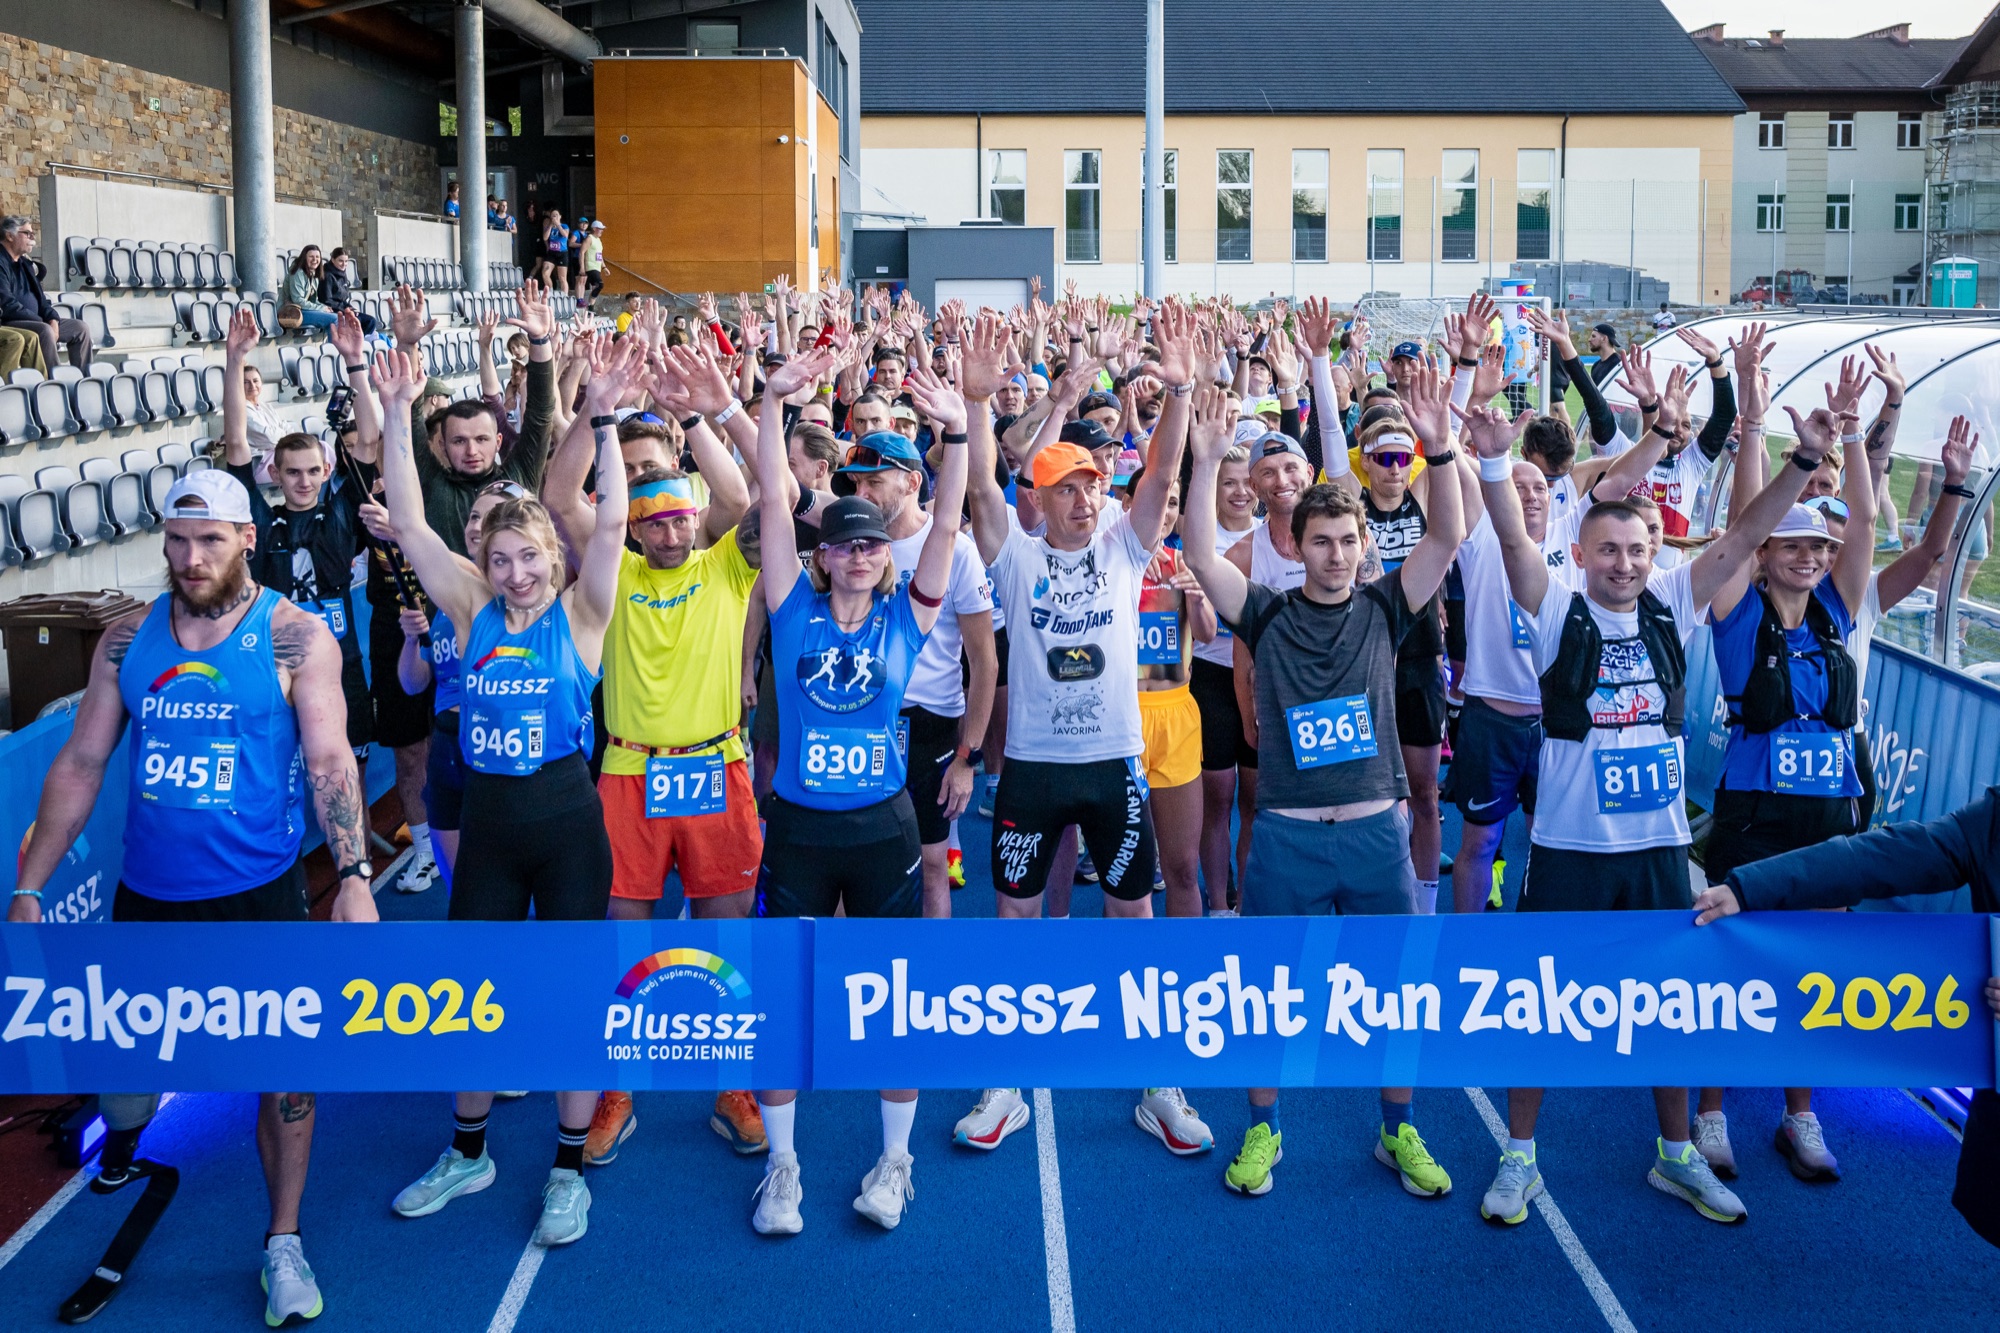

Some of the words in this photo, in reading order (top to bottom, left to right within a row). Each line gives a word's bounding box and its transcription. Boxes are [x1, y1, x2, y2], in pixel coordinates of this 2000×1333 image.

[536, 172, 559, 184] WC
[1366, 516, 1421, 532] COFEE
[1547, 549, 1565, 567] 4F
[809, 690, 837, 711] Zakopane
[471, 726, 523, 757] 946
[1052, 725, 1102, 736] JAVORINA
[1297, 713, 1355, 750] 826
[145, 753, 209, 789] 945
[806, 744, 867, 775] 830
[1778, 748, 1833, 776] 812
[652, 772, 707, 801] 917
[1604, 762, 1660, 794] 811
[997, 830, 1042, 858] NEVER
[1000, 847, 1032, 867] GIVE
[1105, 830, 1140, 888] FARUNO
[1004, 865, 1028, 884] UP
[638, 979, 659, 997] Twój
[658, 969, 708, 983] suplement
[709, 978, 728, 998] diety
[1, 964, 323, 1062] Zakopane
[341, 978, 505, 1036] 2026
[845, 958, 1099, 1041] Plusssz
[1119, 954, 1307, 1058] Night
[1325, 963, 1441, 1047] Run
[1459, 955, 1778, 1055] Zakopane
[1797, 972, 1970, 1032] 2026
[607, 1045, 642, 1060] 100%
[648, 1045, 754, 1060] CODZIENNIE
